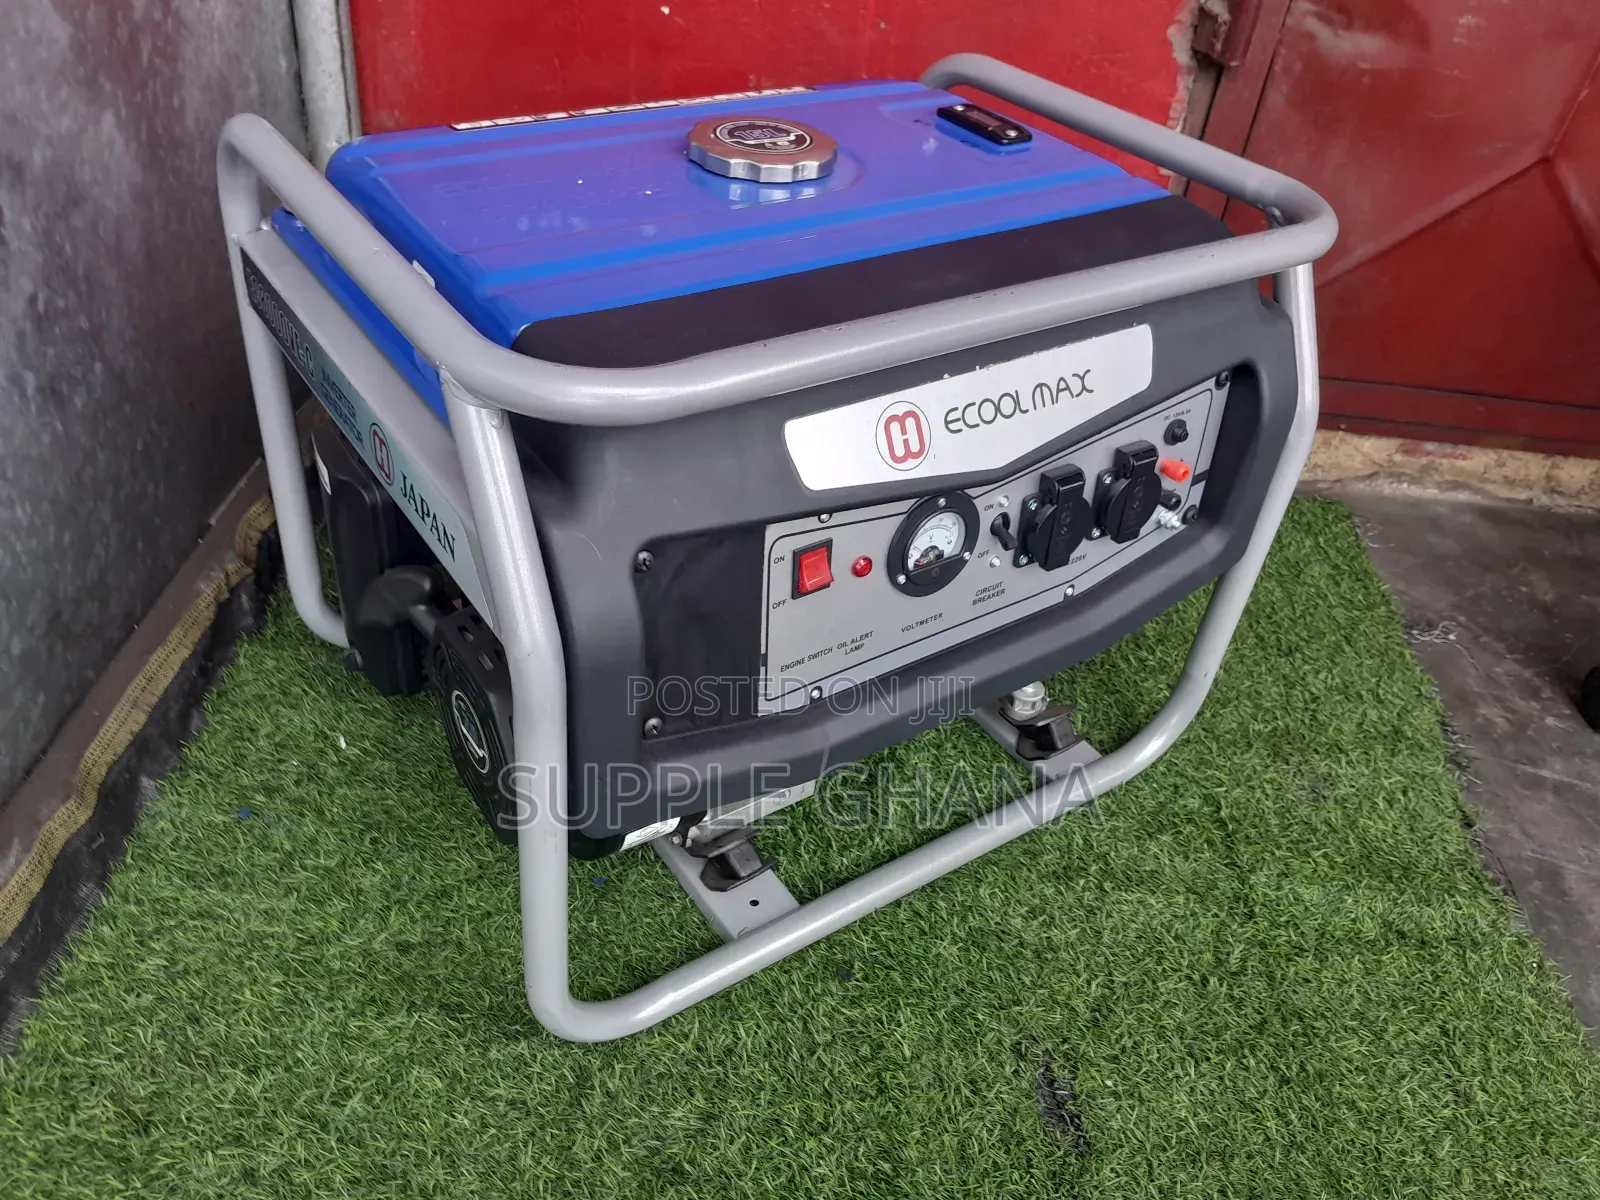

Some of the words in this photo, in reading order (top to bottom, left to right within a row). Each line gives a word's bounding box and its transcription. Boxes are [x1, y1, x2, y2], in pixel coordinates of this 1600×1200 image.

[400, 470, 456, 562] JAPAN
[984, 504, 995, 512] ON
[773, 555, 785, 565] ON
[977, 549, 990, 559] OFF
[972, 588, 1006, 606] BREAKER
[975, 581, 1004, 597] CIRCUIT
[772, 599, 788, 610] OFF
[901, 612, 943, 633] VOLTMETER
[837, 640, 849, 650] OIL
[850, 630, 874, 645] ALERT
[844, 643, 865, 656] LAMP
[780, 657, 806, 672] ENGINE
[807, 647, 833, 662] SWITCH
